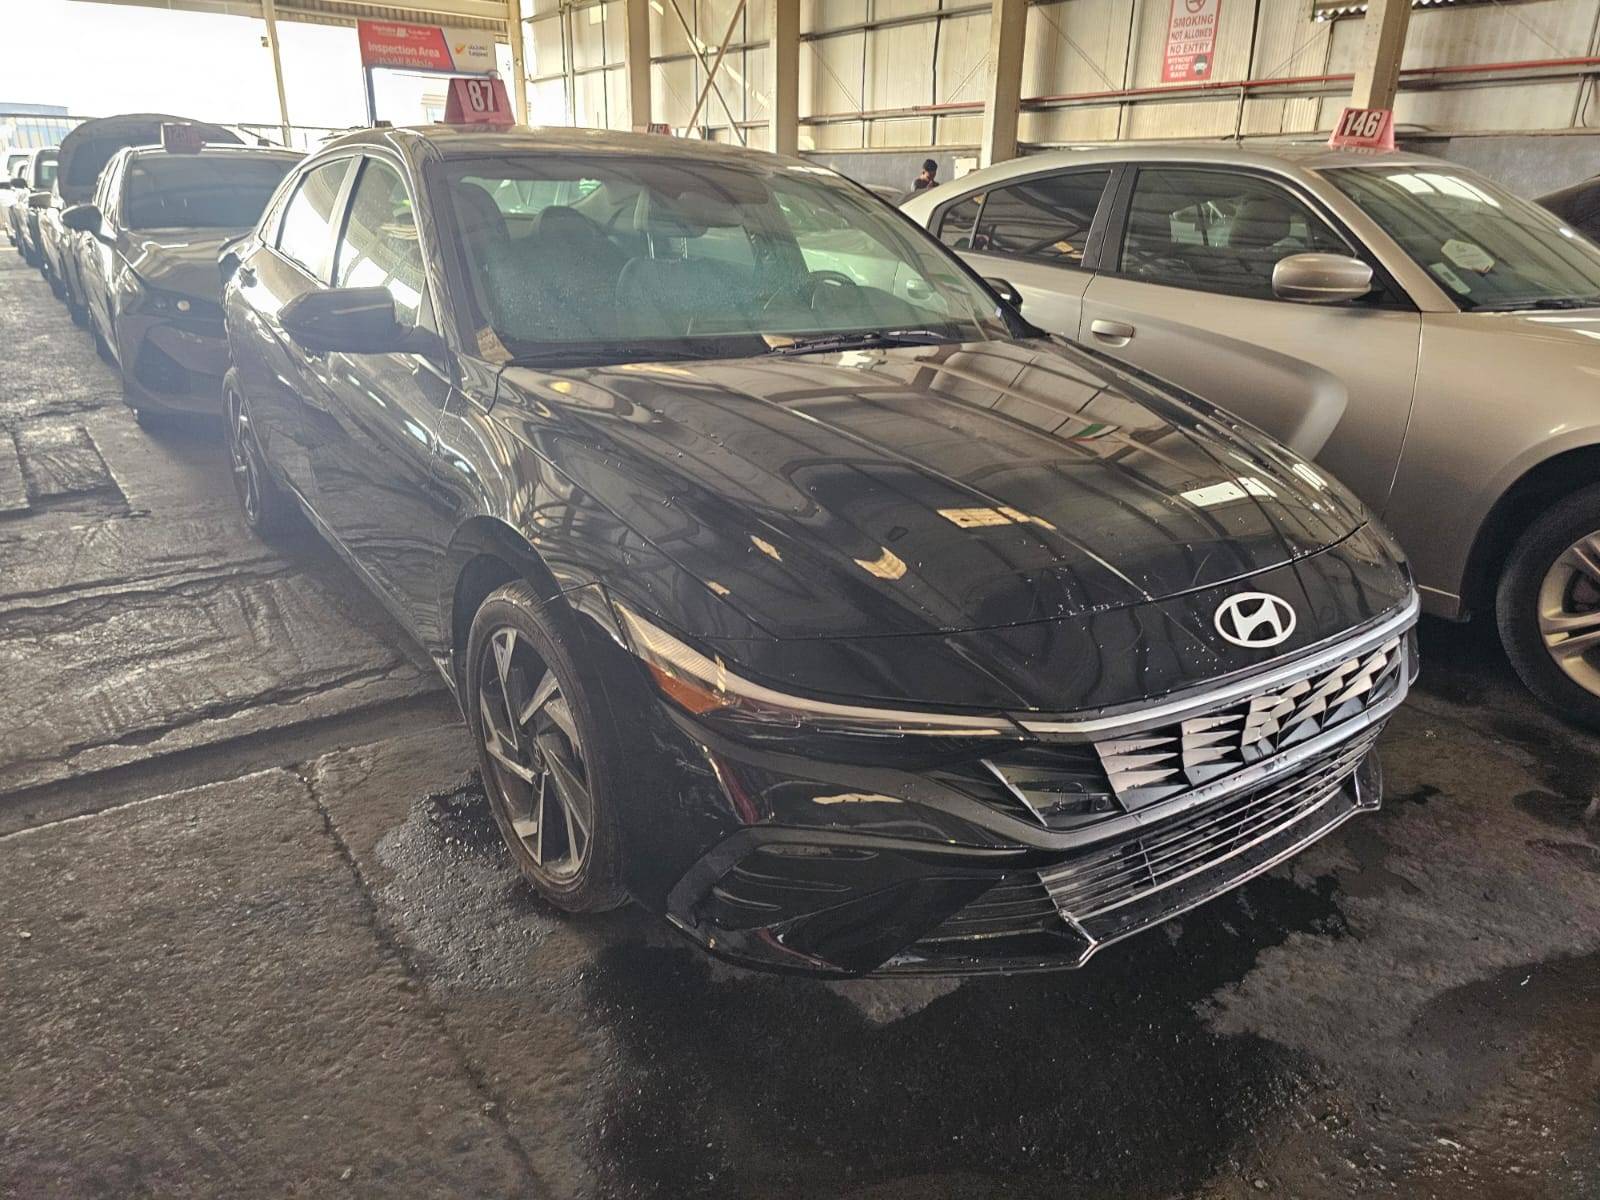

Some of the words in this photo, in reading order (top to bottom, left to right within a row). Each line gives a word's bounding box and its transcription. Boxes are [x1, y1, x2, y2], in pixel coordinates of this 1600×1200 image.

[1173, 15, 1213, 28] SMOKING
[1171, 31, 1183, 40] NOT
[1184, 28, 1212, 39] ALLOWED
[368, 41, 417, 55] Inspection
[419, 46, 440, 58] Area
[1170, 45, 1181, 54] NO
[1183, 43, 1209, 53] ENTRY
[467, 80, 494, 112] 87
[1344, 111, 1381, 137] 146
